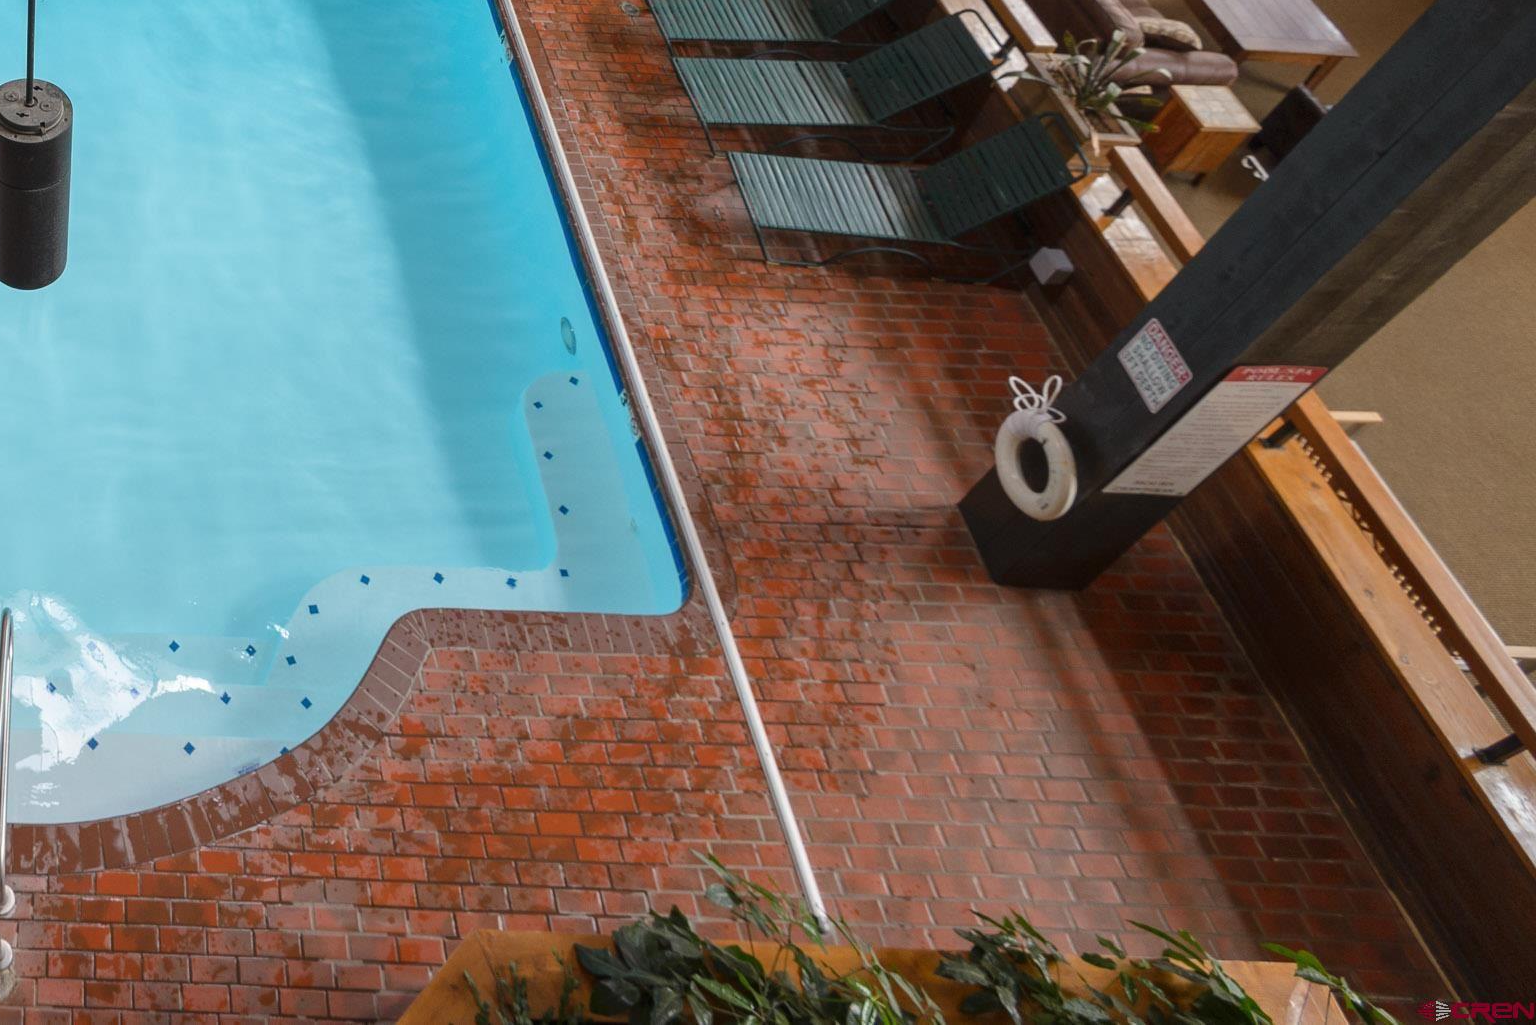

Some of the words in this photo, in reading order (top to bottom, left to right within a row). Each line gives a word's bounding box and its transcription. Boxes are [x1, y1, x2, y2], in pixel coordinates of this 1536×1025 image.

[1131, 342, 1169, 396] SHALLOW
[1134, 369, 1161, 407] DEPTH
[1138, 332, 1154, 352] NO
[1148, 349, 1178, 390] DIVING
